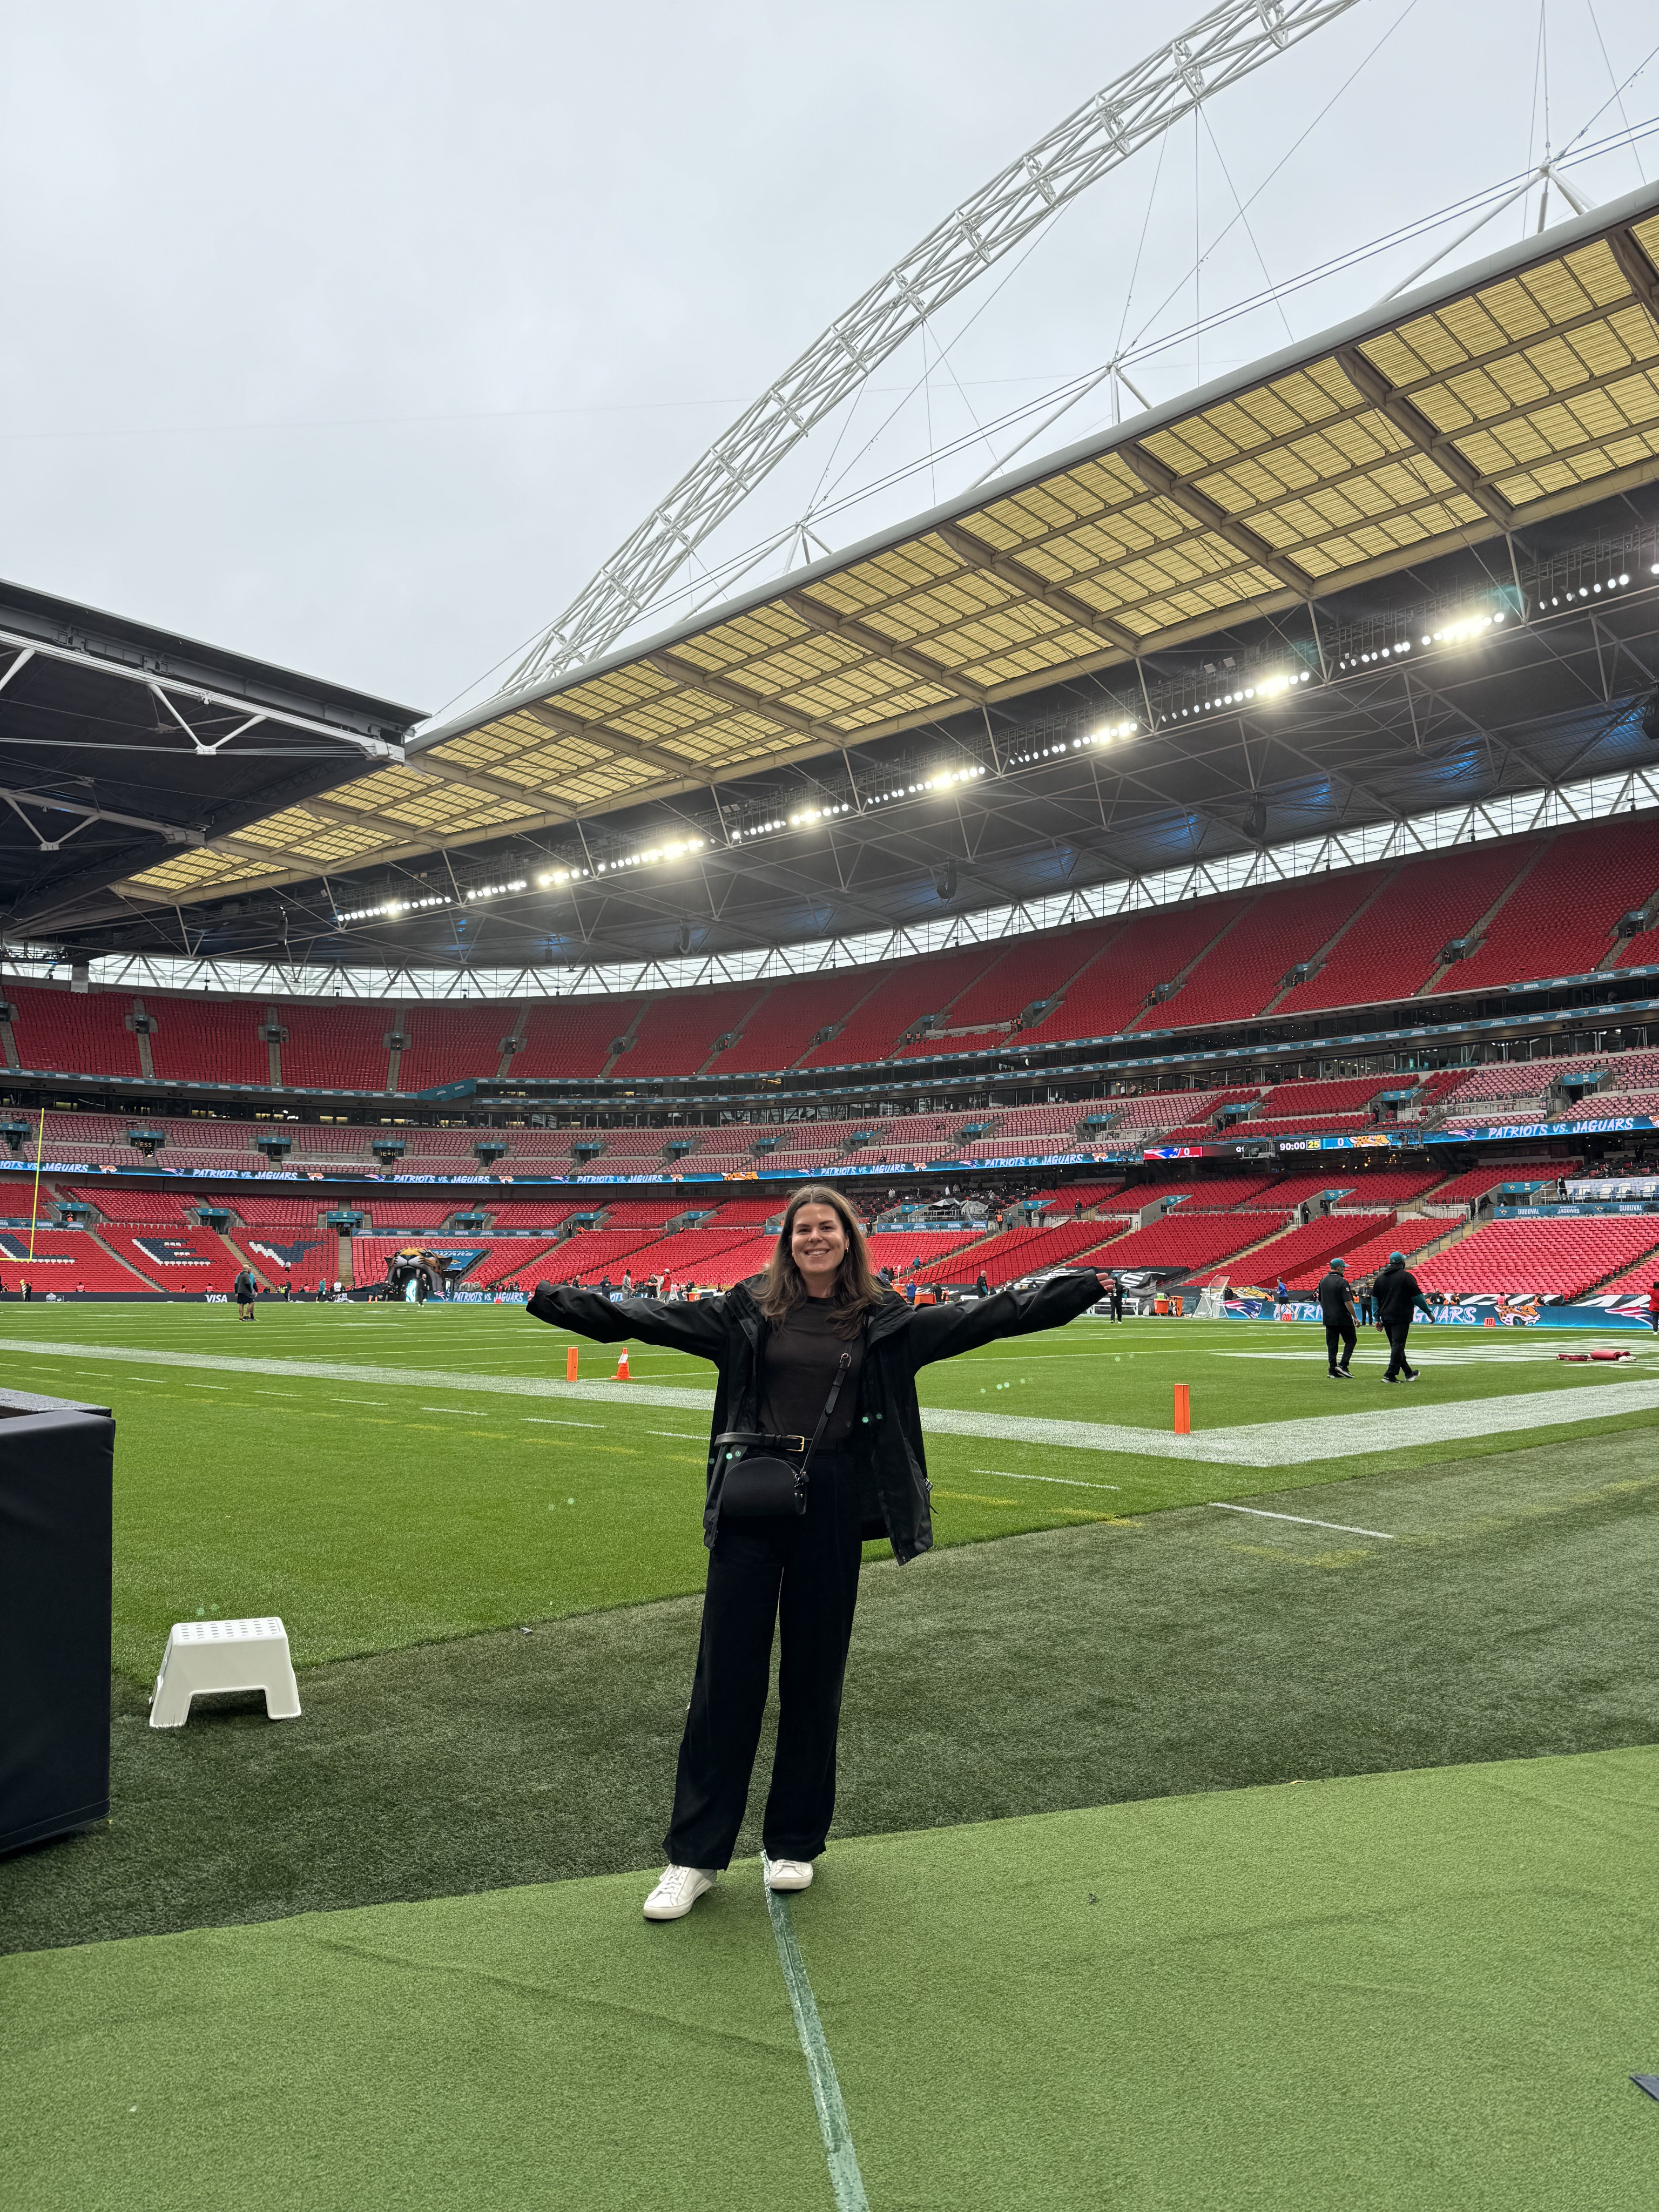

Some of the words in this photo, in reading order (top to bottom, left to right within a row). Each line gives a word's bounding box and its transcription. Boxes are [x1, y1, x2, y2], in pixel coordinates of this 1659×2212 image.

[1488, 1124, 1549, 1139] PATRIOTS
[1552, 1124, 1569, 1132] VS.
[1573, 1117, 1634, 1134] JAGUARS
[1280, 1142, 1305, 1151] 90:00
[1308, 1141, 1320, 1149] 25
[1337, 1138, 1344, 1147] 0
[1184, 1148, 1190, 1156] 0
[984, 1157, 1026, 1168] PATRIOTS
[1041, 1154, 1083, 1165] JAGUARS
[42, 1163, 89, 1172] JAGUARS
[821, 1166, 857, 1176] PATRIOTS
[870, 1164, 906, 1174] JAGUARS
[193, 1169, 239, 1178] PATRIOTS
[255, 1171, 298, 1180] JAGUARS
[394, 1175, 436, 1183] PATRIOTS
[450, 1176, 490, 1184] JAGUARS
[577, 1175, 615, 1183] PATRIOTS
[628, 1175, 663, 1183] JAGUARS
[204, 1294, 228, 1303] VISA
[453, 1292, 483, 1303] PATRIOTS
[494, 1292, 524, 1303] JAGUARS
[1273, 1303, 1323, 1320] PATRI
[1413, 1305, 1476, 1324] GUARS
